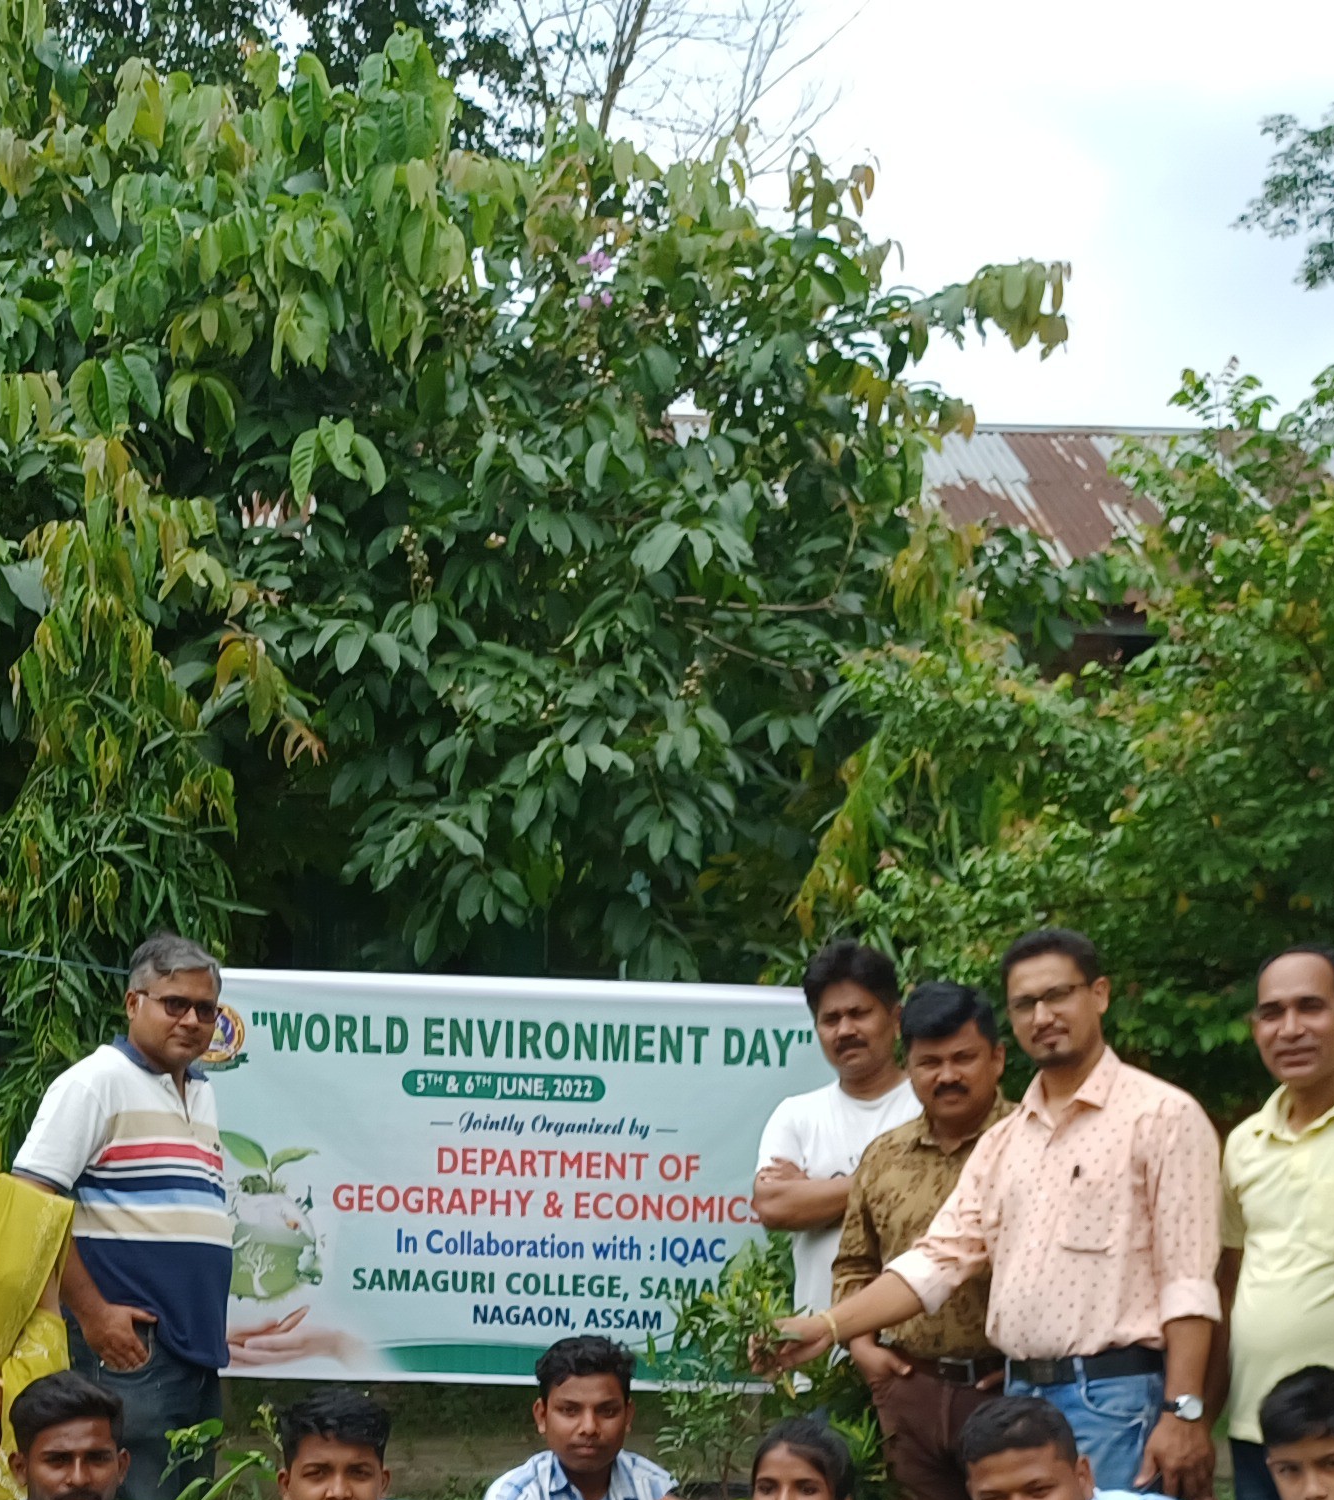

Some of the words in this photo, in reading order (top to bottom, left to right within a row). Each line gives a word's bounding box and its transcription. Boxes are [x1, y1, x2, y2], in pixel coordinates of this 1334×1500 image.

[252, 1011, 409, 1054] "WORLD
[423, 1016, 710, 1065] ENVIRONMENT
[723, 1026, 812, 1067] DAY"
[446, 1074, 459, 1094] &
[495, 1076, 549, 1100] JUNE,
[553, 1079, 593, 1099] 2022
[459, 1110, 525, 1136] Jointly
[531, 1113, 625, 1137] Organized
[629, 1117, 650, 1140] by
[437, 1147, 649, 1180] DEPARTMENT
[658, 1153, 700, 1183] OF
[332, 1184, 534, 1217] GEOGRAPHY
[543, 1191, 563, 1218] &
[396, 1229, 417, 1254] In
[426, 1229, 584, 1259] Collaboration
[593, 1235, 642, 1261] with
[352, 1268, 495, 1294] SAMAGURI
[505, 1272, 630, 1302] COLLEGE,
[473, 1304, 576, 1331] NAGAON,
[584, 1308, 663, 1330] ASSAM
